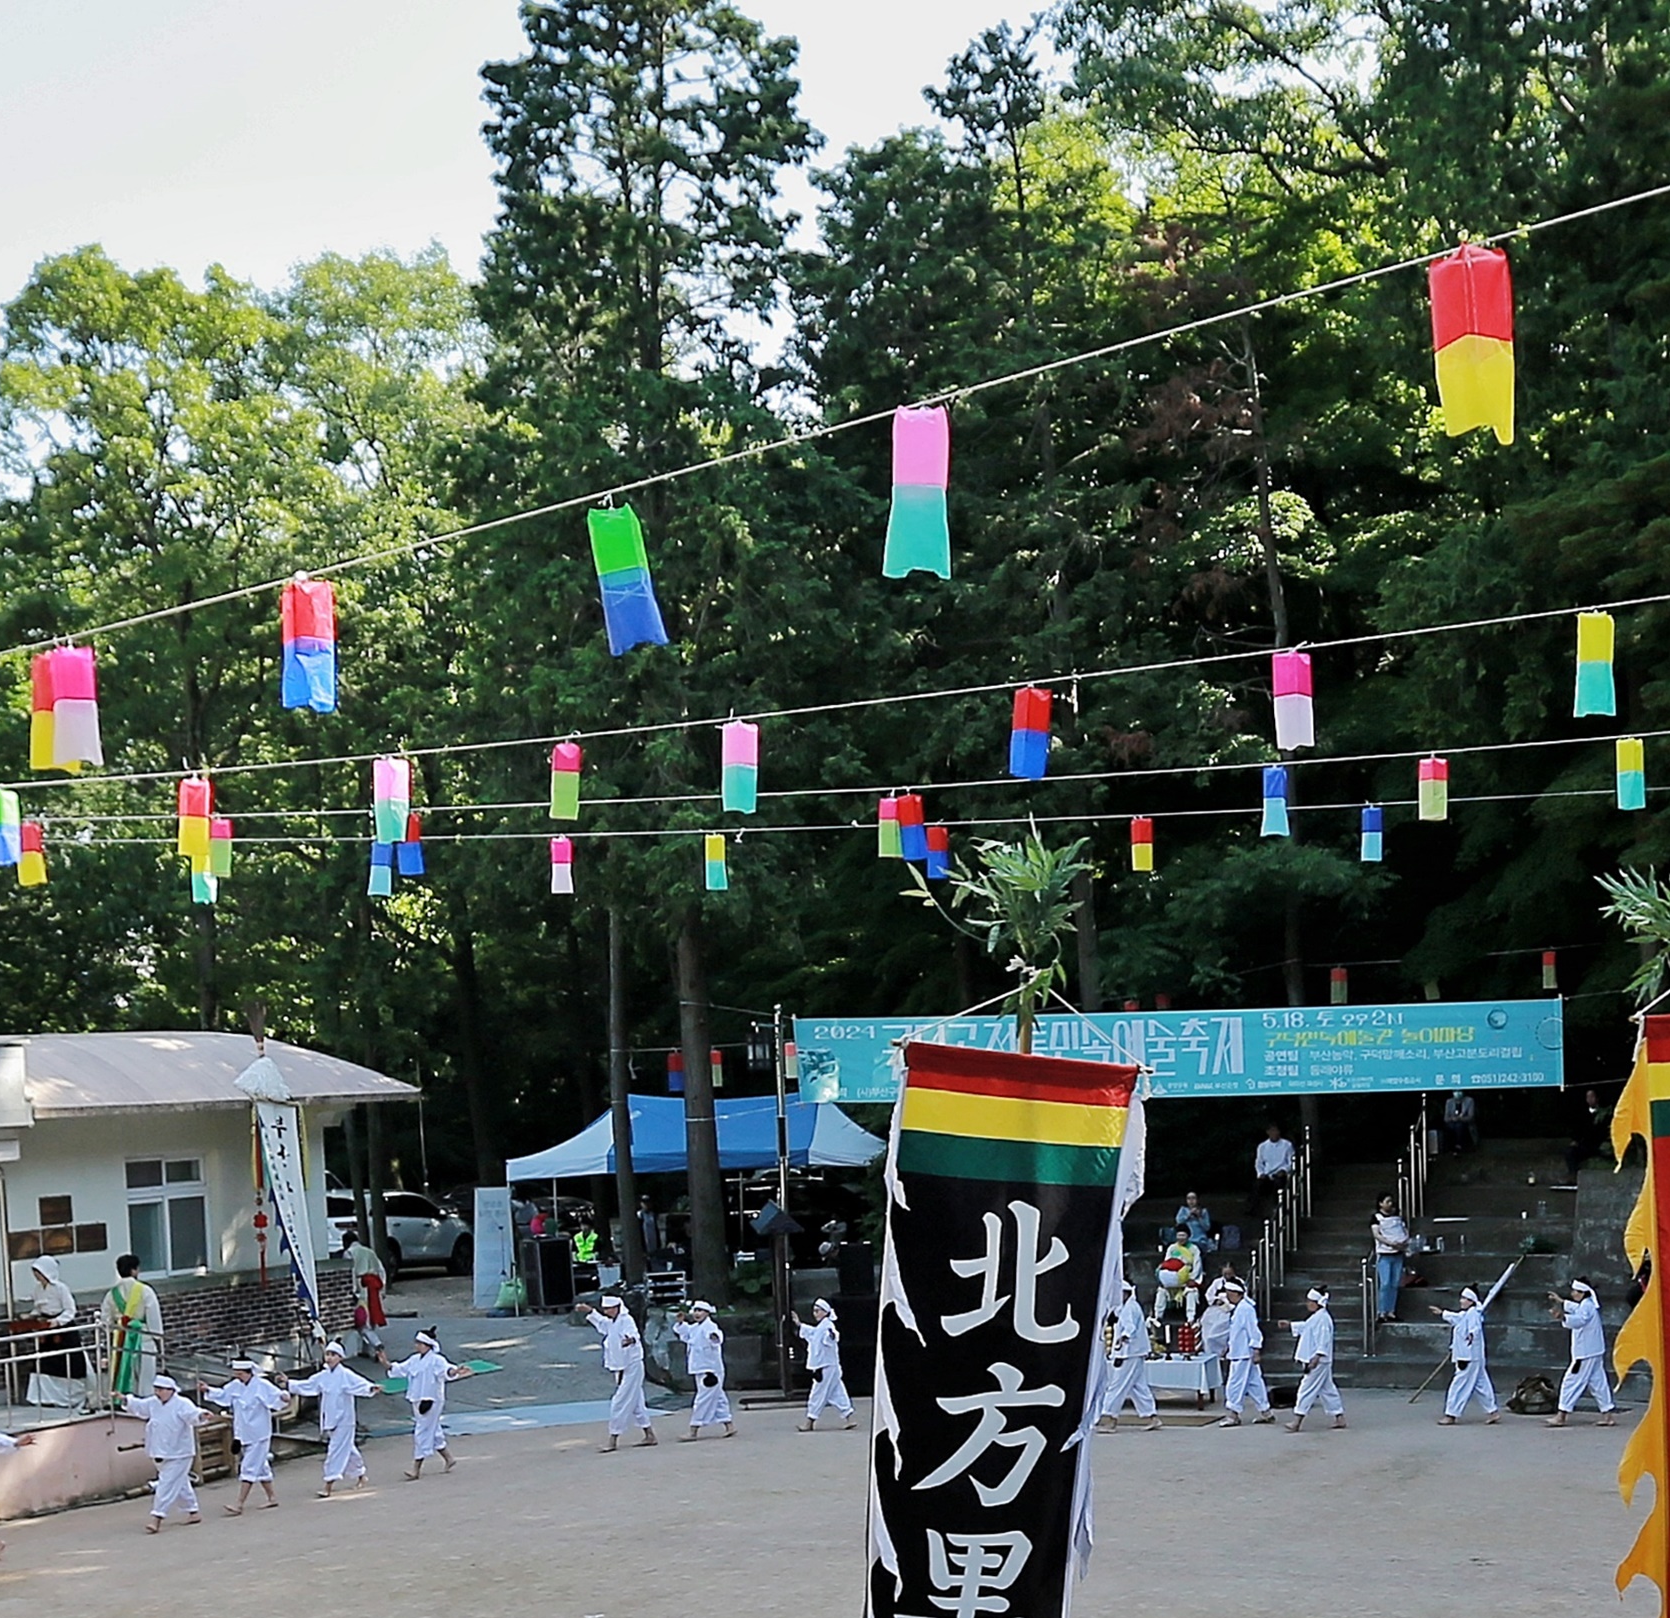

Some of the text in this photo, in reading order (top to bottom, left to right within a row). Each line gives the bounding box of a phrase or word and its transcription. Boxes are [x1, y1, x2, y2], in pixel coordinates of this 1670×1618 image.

[1262, 1012, 1310, 1029] 5.18.
[1316, 1010, 1335, 1028] 토
[813, 1024, 876, 1040] 2024
